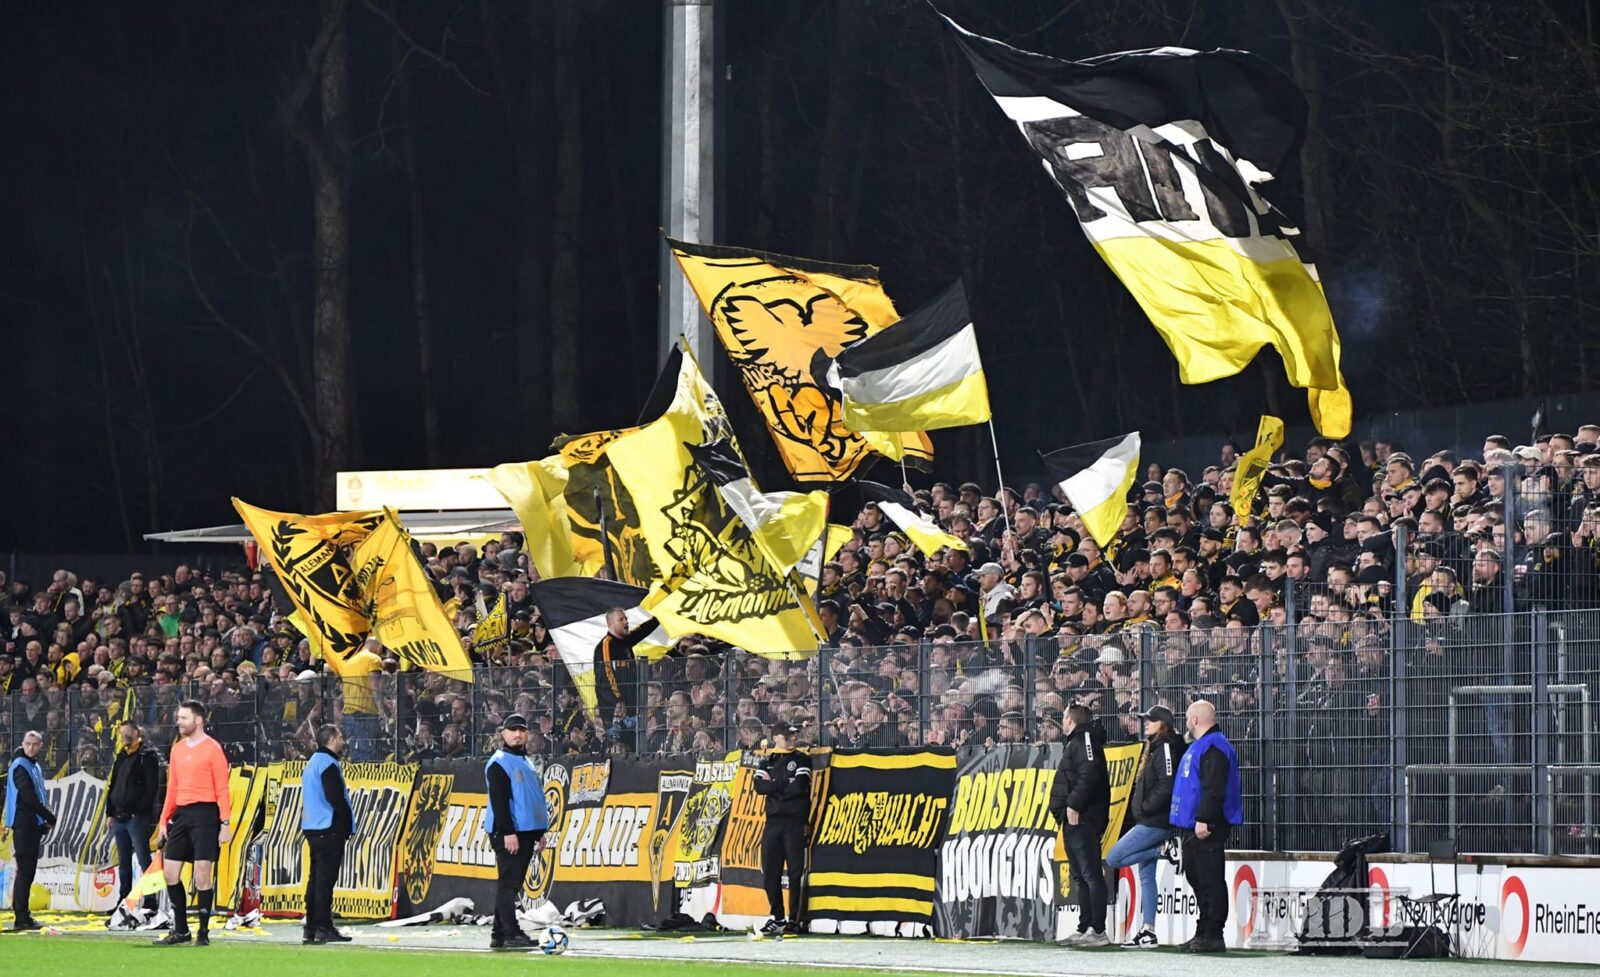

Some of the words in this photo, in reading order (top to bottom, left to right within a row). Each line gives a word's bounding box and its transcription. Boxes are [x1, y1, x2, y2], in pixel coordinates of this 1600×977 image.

[301, 545, 337, 574] ALEMAN
[560, 805, 648, 868] BANDE
[942, 832, 1056, 906] HOOLIGANS
[1535, 903, 1600, 935] RheinEne
